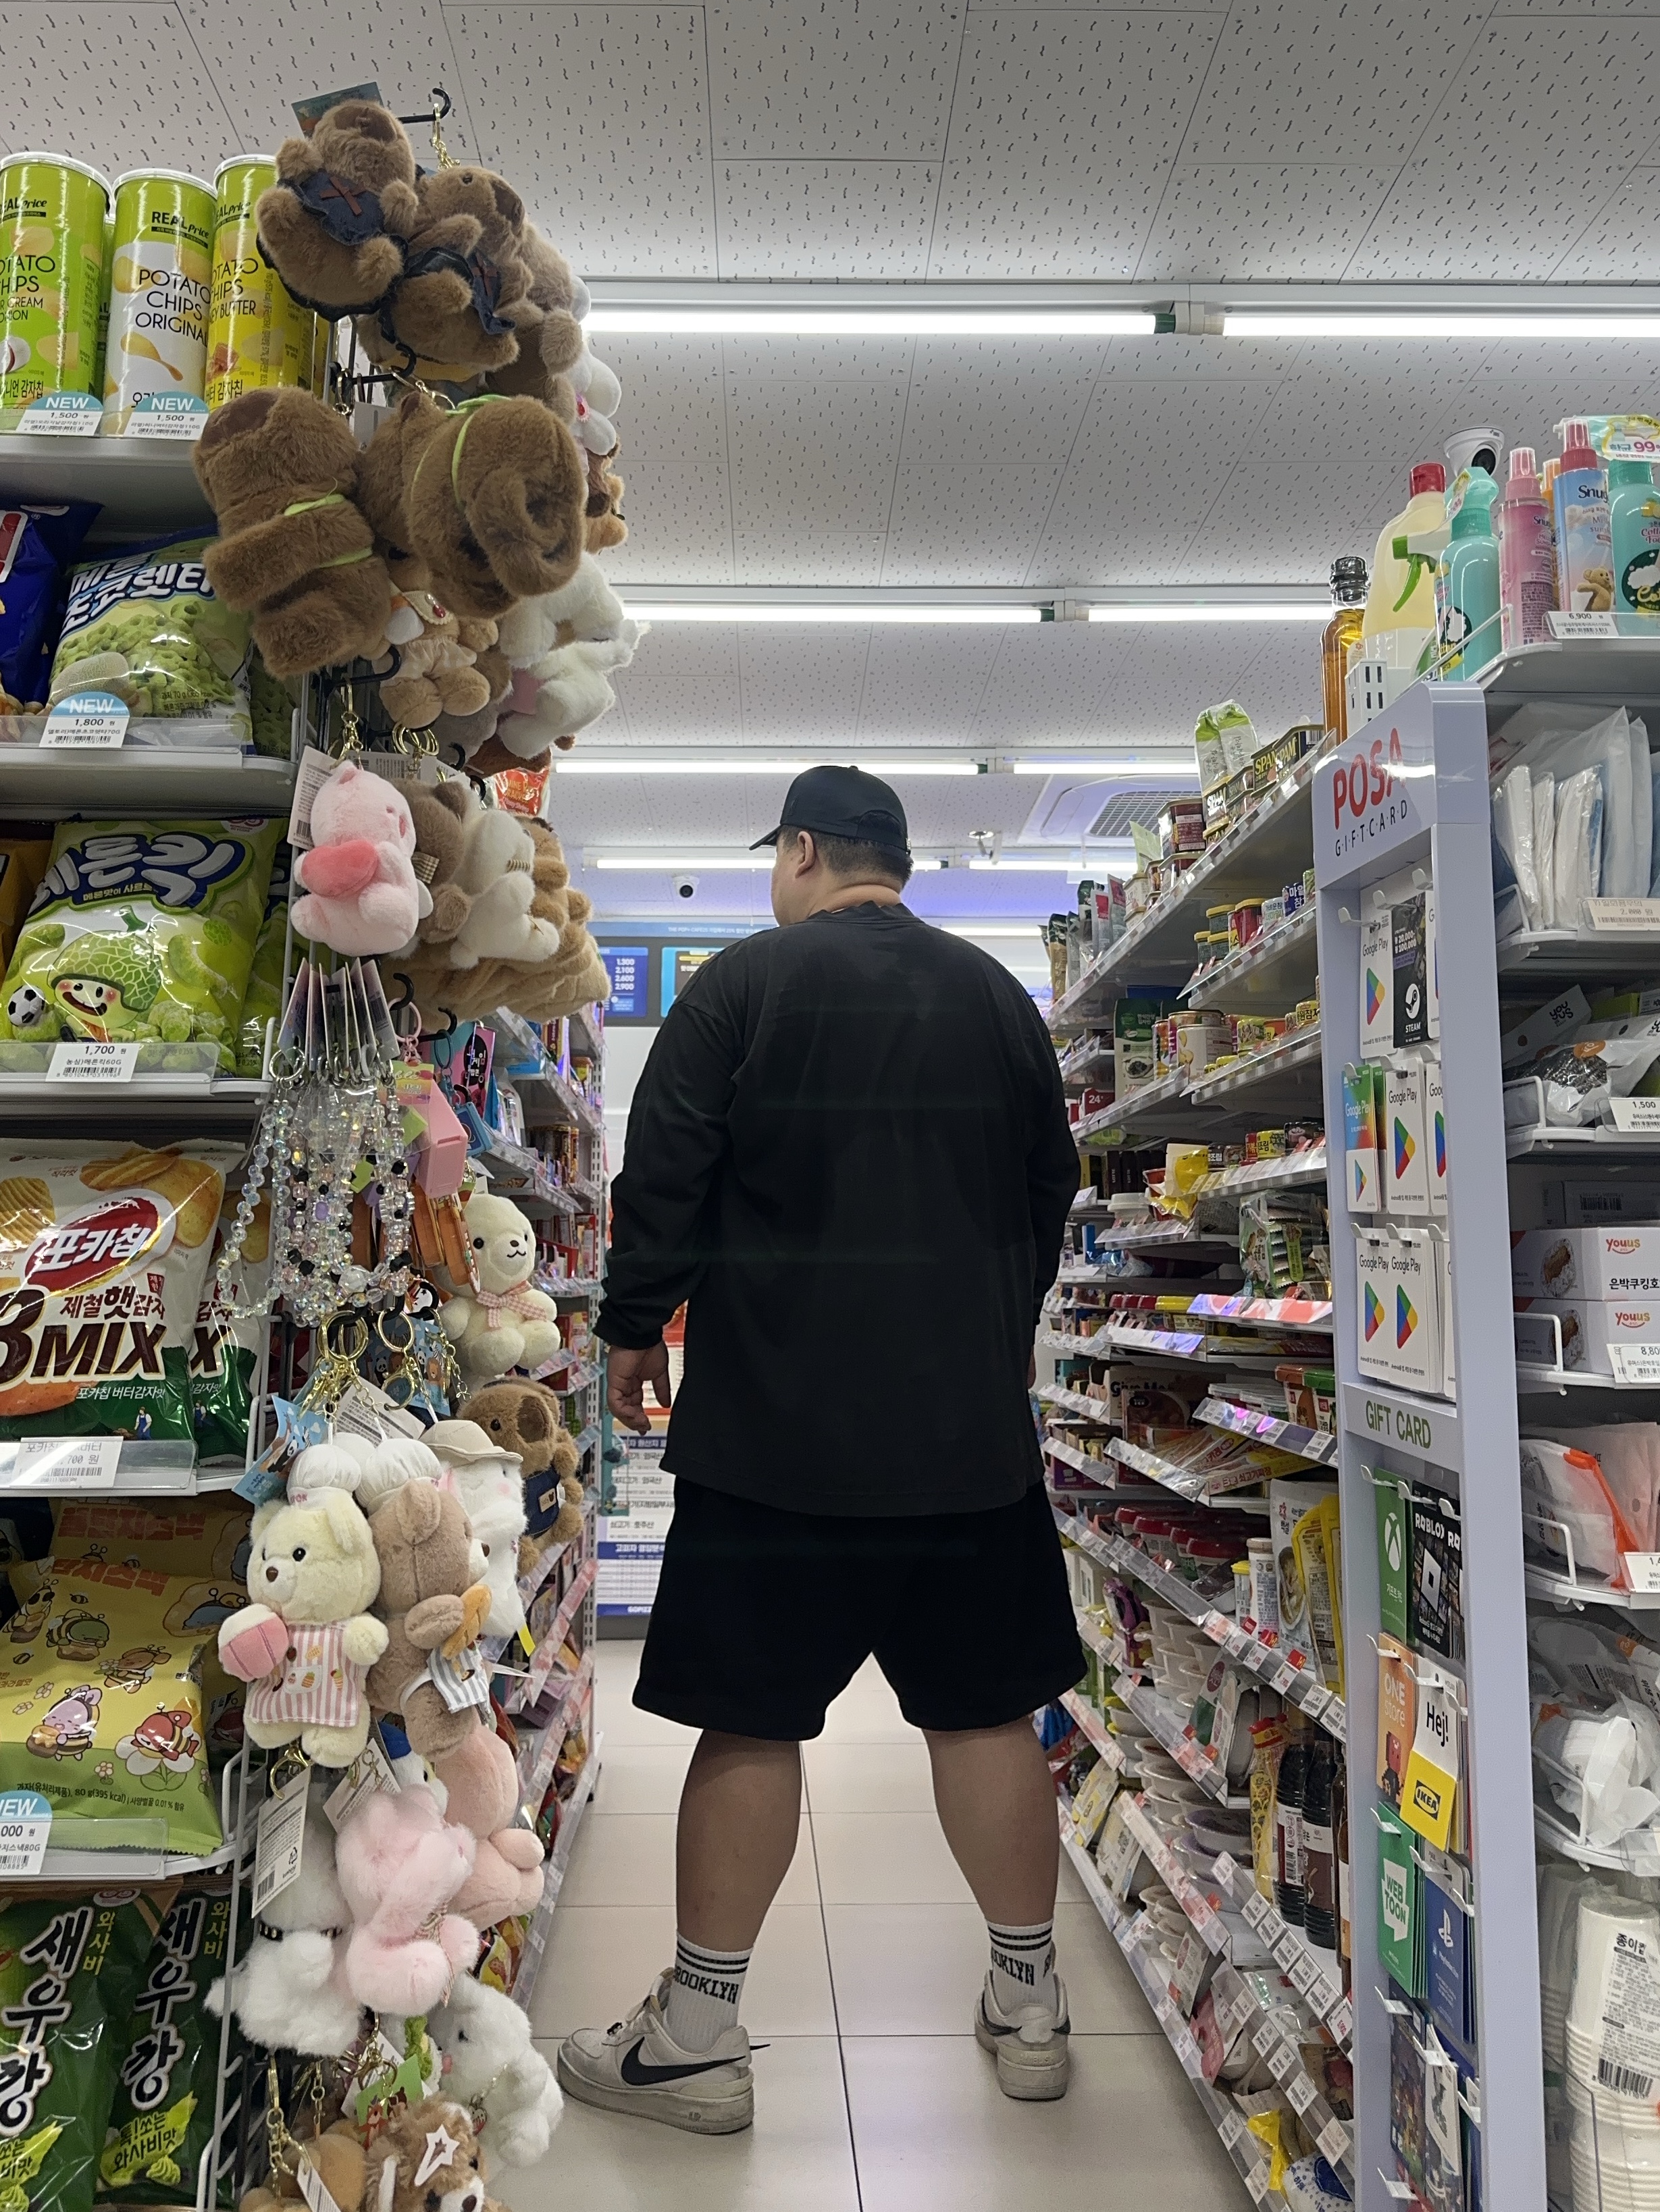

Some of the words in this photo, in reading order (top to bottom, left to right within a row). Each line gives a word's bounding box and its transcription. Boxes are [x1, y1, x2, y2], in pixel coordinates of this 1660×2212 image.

[139, 269, 211, 305] POTATO
[146, 290, 203, 321] CHIPS
[135, 312, 208, 348] ORIGINAL
[21, 379, 43, 401] 감자칩
[45, 396, 90, 409] NEW
[151, 397, 194, 411] NEW
[69, 699, 113, 714] NEW
[74, 718, 104, 727] 1,800
[1332, 727, 1407, 830] POSA
[1362, 943, 1378, 957] Google
[1378, 938, 1389, 951] Play
[1405, 1022, 1422, 1034] STEAM
[84, 1045, 115, 1055] 1,700
[1389, 1090, 1407, 1106] Google
[1407, 1088, 1418, 1104] Play
[1632, 1101, 1657, 1109] 1,500
[1345, 1102, 1361, 1119] Google
[38, 1223, 151, 1271] 포카칩
[1605, 1238, 1641, 1252] youus
[1359, 1254, 1378, 1270] Google
[1378, 1255, 1389, 1273] Play
[1391, 1255, 1410, 1274] Google
[1410, 1258, 1422, 1275] Play
[1609, 1278, 1660, 1291] 은박쿠킹호
[1615, 1311, 1651, 1325] youus
[76, 1385, 111, 1401] 포카칩
[111, 1384, 166, 1401] 버터감자맛
[1366, 1400, 1392, 1436] GIFT
[1396, 1411, 1431, 1449] CARD
[88, 1454, 99, 1465] 원
[1384, 1675, 1405, 1706] ONE
[1384, 1701, 1406, 1727] store
[1426, 1702, 1449, 1748] Hej!
[74, 1788, 86, 1796] 80
[1416, 1787, 1438, 1812] IKEA
[0, 1798, 38, 1816] EW
[1386, 1873, 1404, 1899] WEB
[1384, 1891, 1407, 1926] TOON
[204, 1901, 231, 1959] 와사비
[83, 1911, 115, 1976] 와사비
[1616, 1932, 1647, 1956] 종이컵
[113, 2128, 177, 2174] 와사비맛
